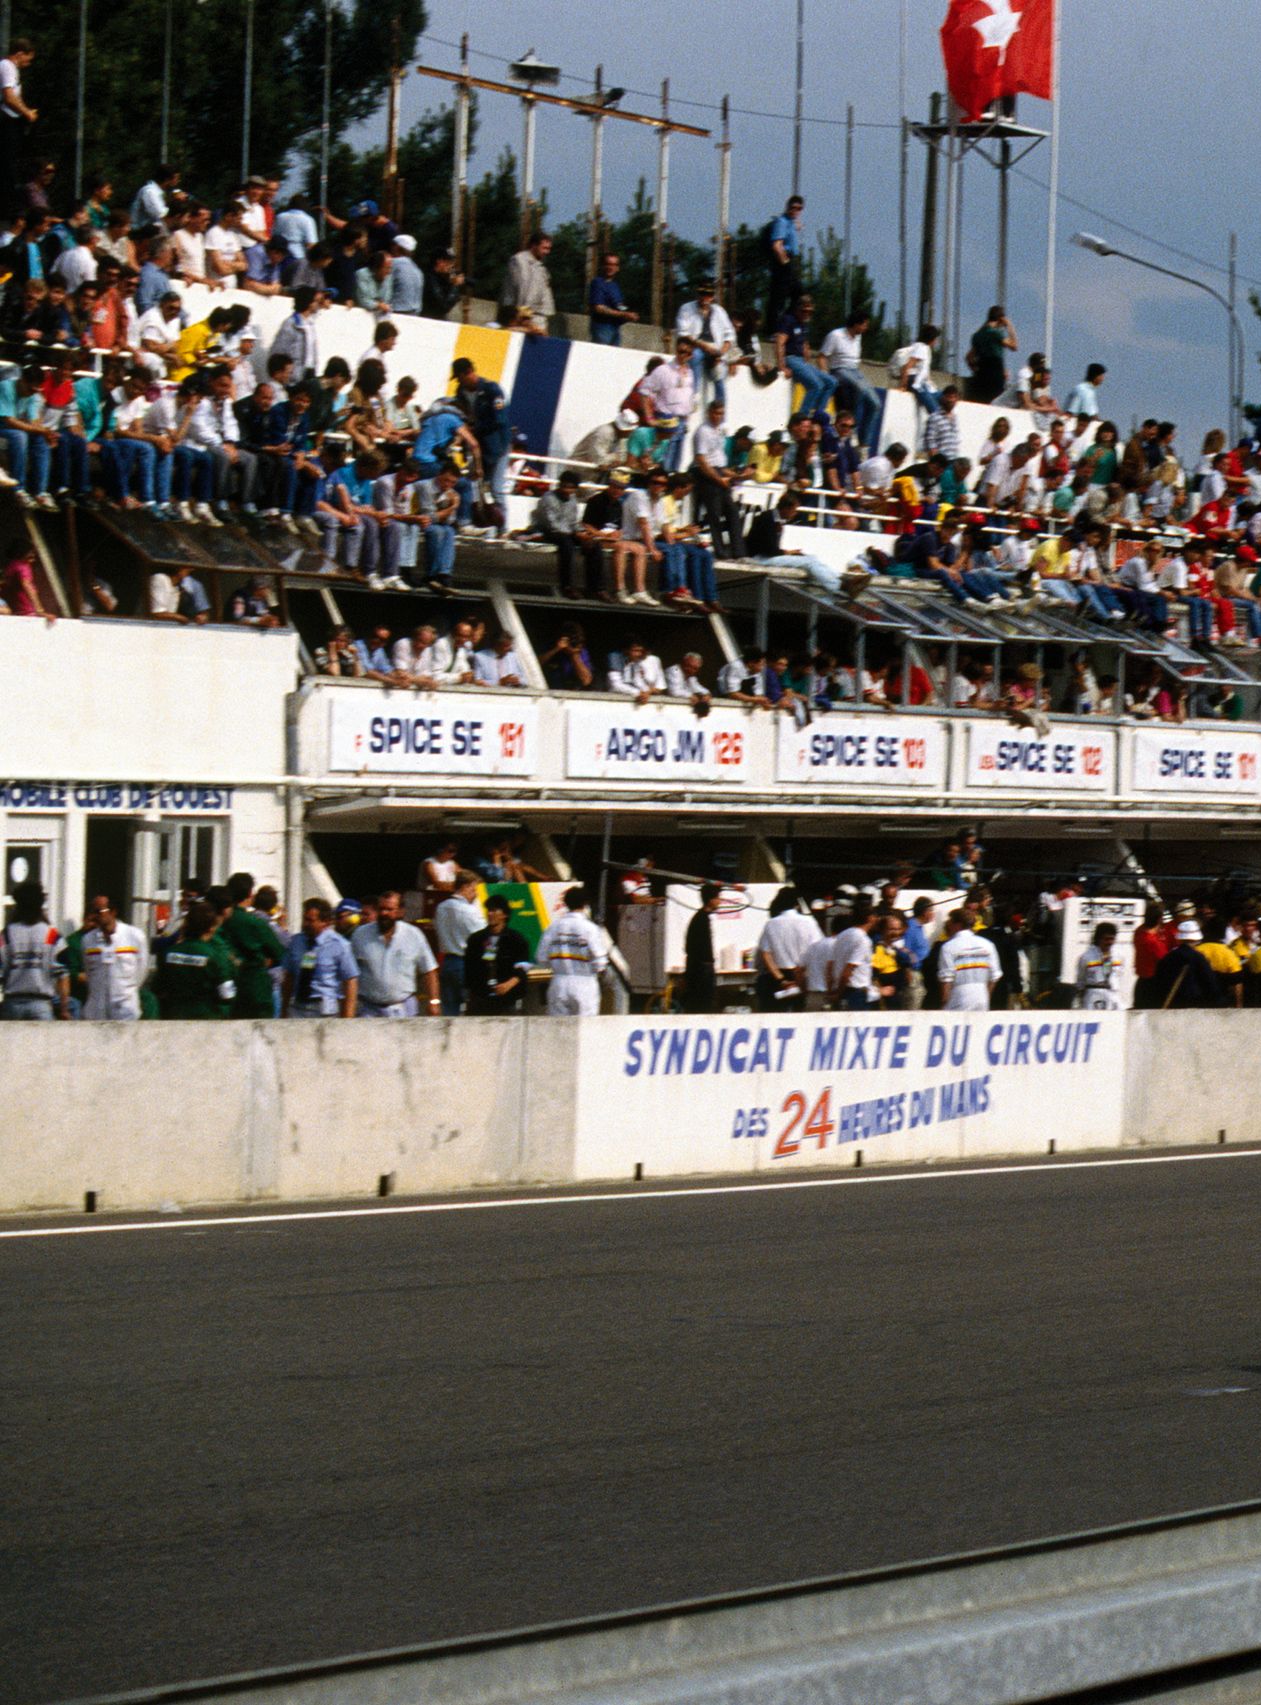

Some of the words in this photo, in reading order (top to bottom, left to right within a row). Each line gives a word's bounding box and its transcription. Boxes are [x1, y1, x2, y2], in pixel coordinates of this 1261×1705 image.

[370, 716, 443, 754] SPICE
[452, 720, 483, 756] SE
[605, 727, 668, 763] ARGO
[672, 730, 704, 764] JM
[810, 734, 867, 767] SPICE
[874, 735, 898, 767] SE
[996, 741, 1047, 773] SPICE
[1054, 744, 1075, 774] SE
[1159, 748, 1206, 778] SPICE
[1214, 751, 1233, 779] SE
[625, 1027, 794, 1076] SYNDICAT
[809, 1026, 910, 1072] MIXTE
[925, 1025, 970, 1069] DU
[986, 1022, 1099, 1066] CIRCUIT
[732, 1107, 769, 1139] DES
[772, 1086, 834, 1160] 24
[838, 1092, 907, 1145] HEURES
[909, 1086, 934, 1128] DU
[938, 1075, 992, 1124] MANS
